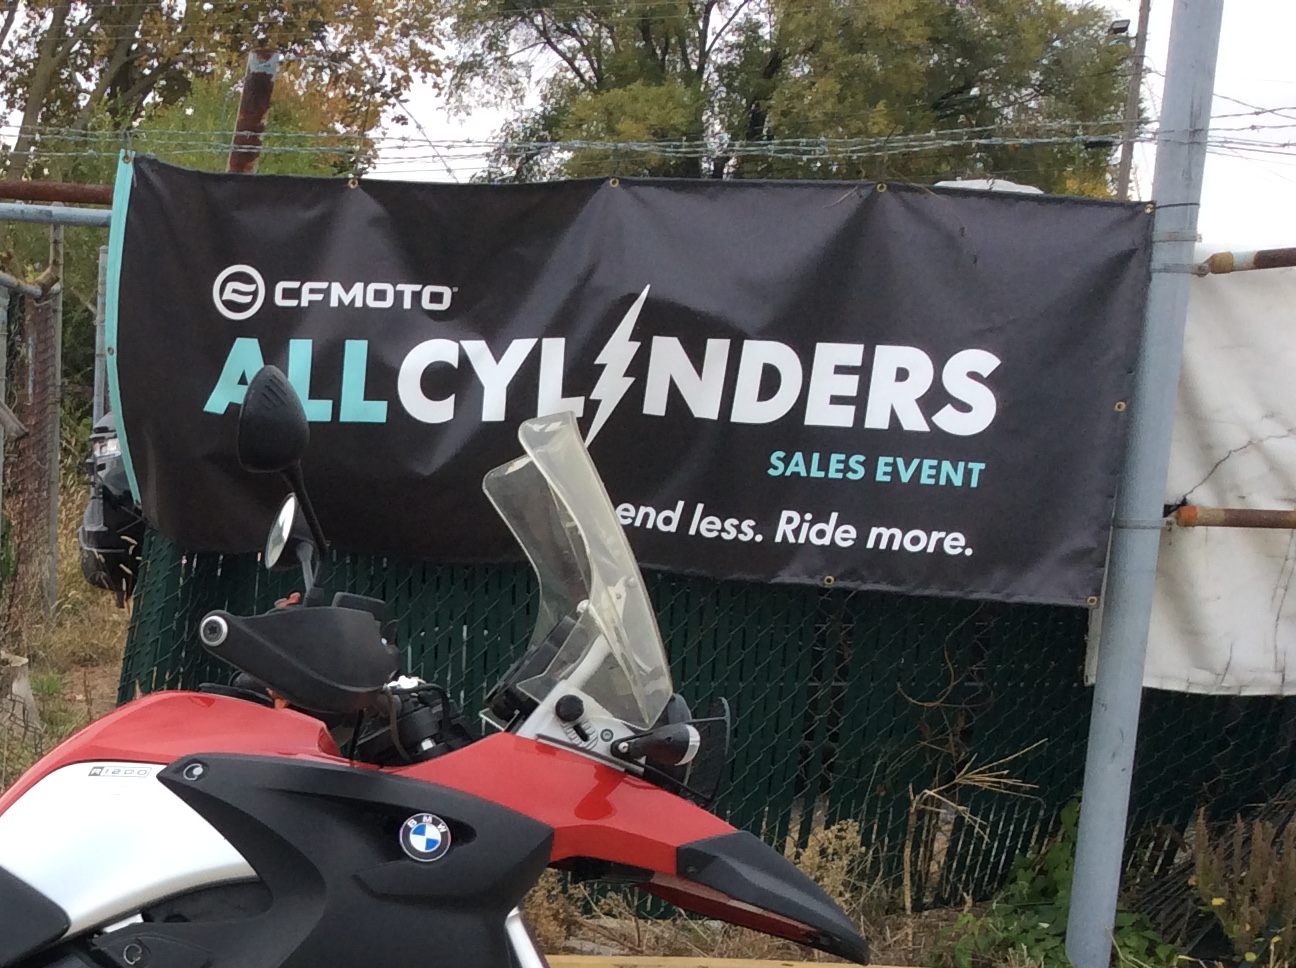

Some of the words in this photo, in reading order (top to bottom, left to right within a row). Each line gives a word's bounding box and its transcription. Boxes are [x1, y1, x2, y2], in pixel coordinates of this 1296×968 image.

[274, 281, 453, 311] CFMOTO
[767, 451, 867, 480] SALES
[875, 456, 986, 488] EVENT
[615, 500, 685, 533] end
[688, 503, 763, 543] less.
[774, 510, 857, 547] Ride
[866, 526, 973, 556] more.
[407, 815, 447, 832] BMW
